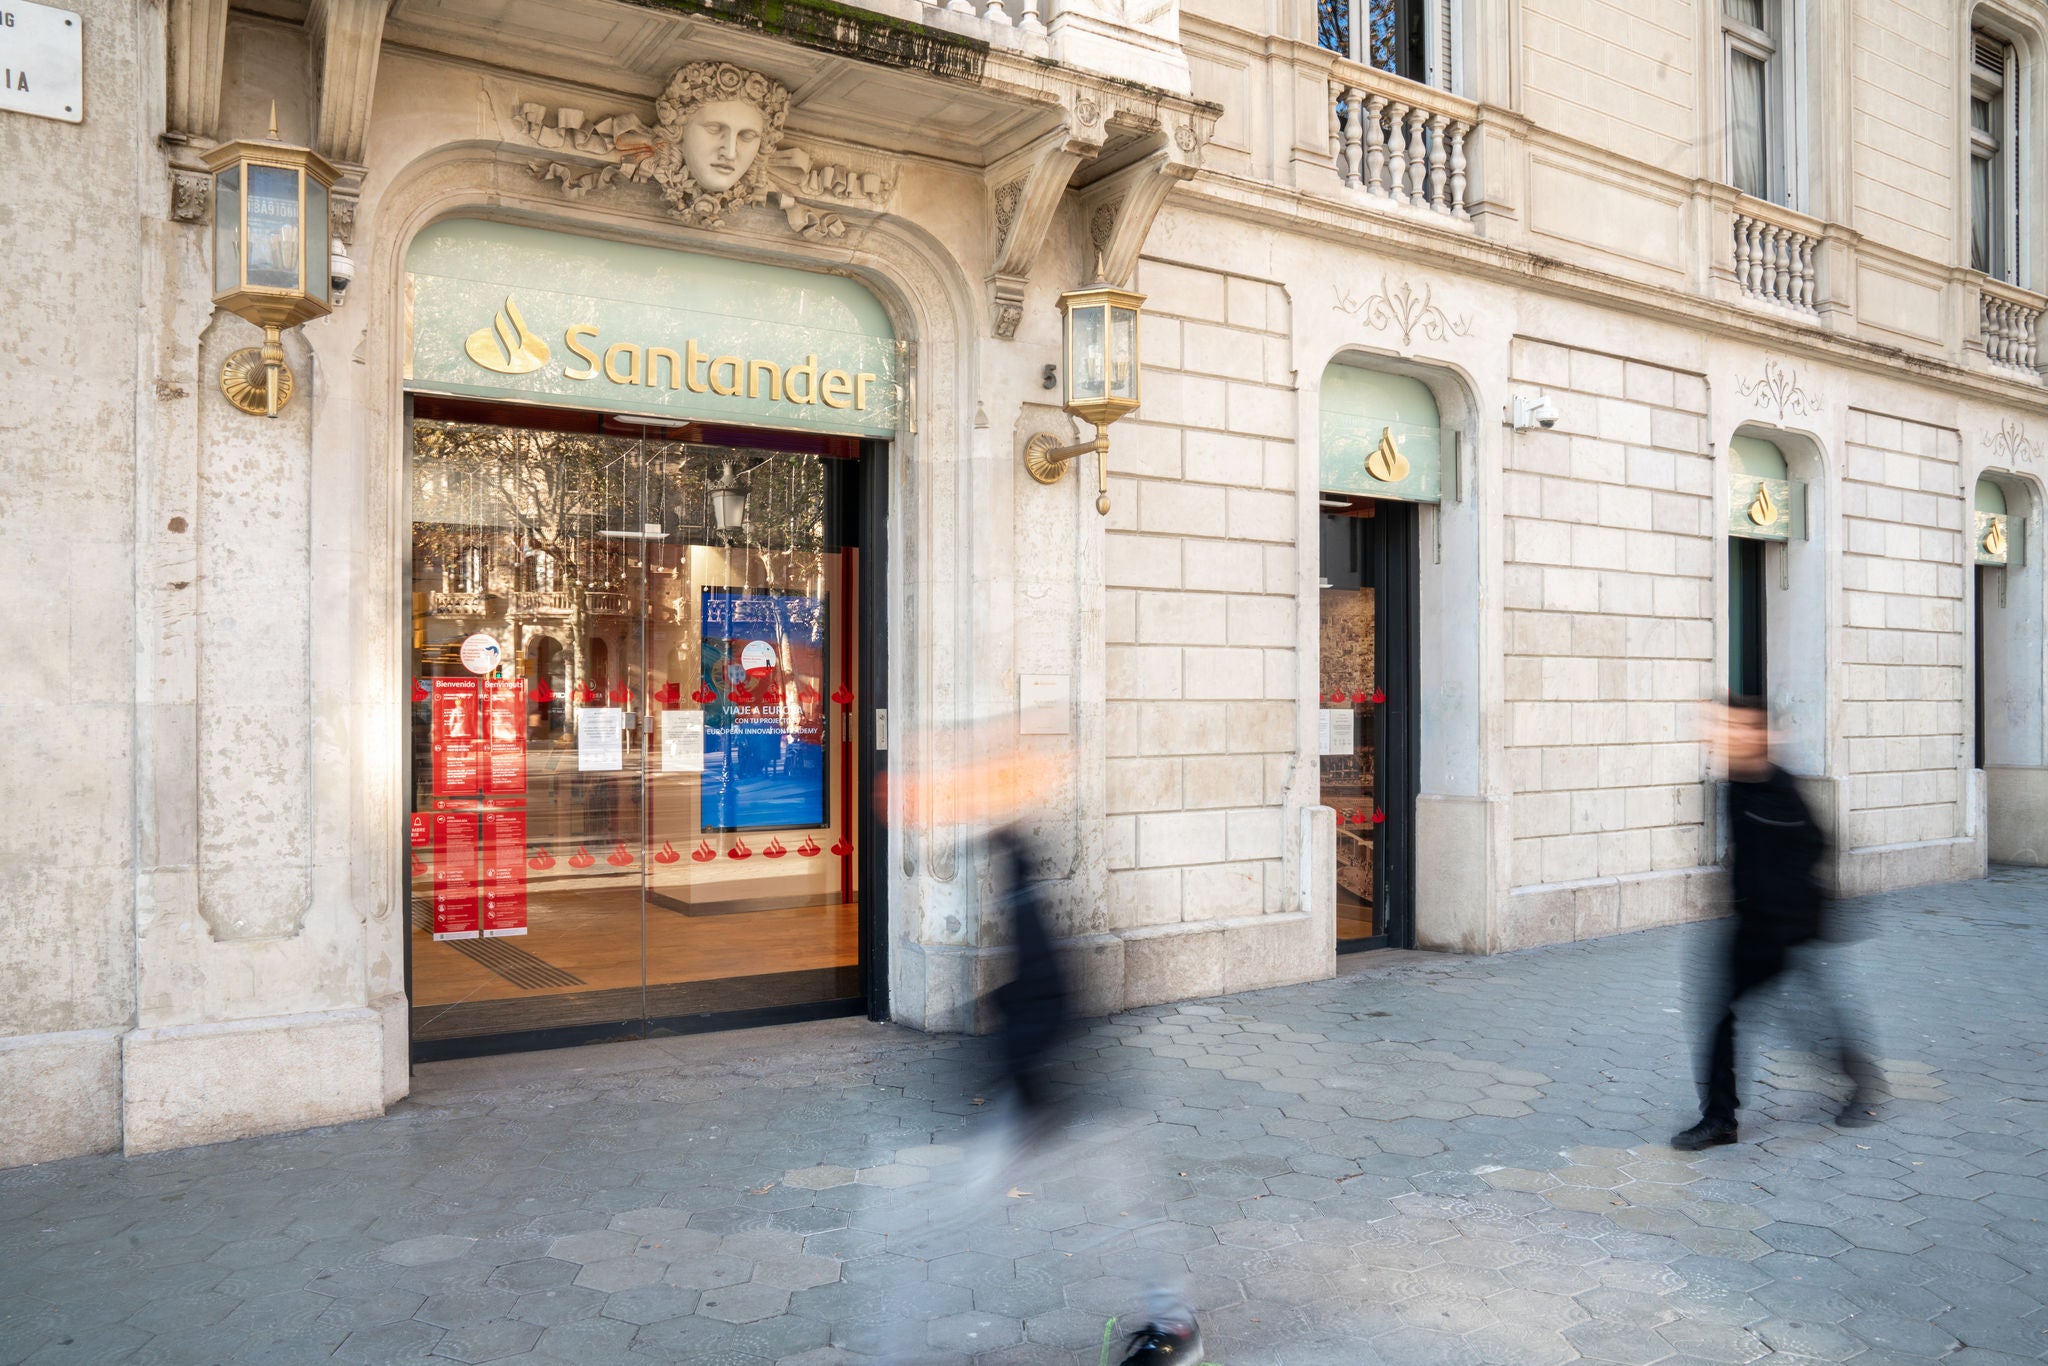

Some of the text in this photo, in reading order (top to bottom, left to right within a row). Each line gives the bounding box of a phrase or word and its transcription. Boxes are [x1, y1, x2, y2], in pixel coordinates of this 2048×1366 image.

[562, 322, 876, 411] Santander
[1042, 363, 1057, 390] 5
[435, 680, 476, 689] Bienvenido
[722, 705, 803, 715] VIAJE A EUROA
[734, 717, 749, 725] CON
[750, 717, 759, 725] TU
[706, 727, 818, 735] EUROPEAN INNOVATION ADEMY
